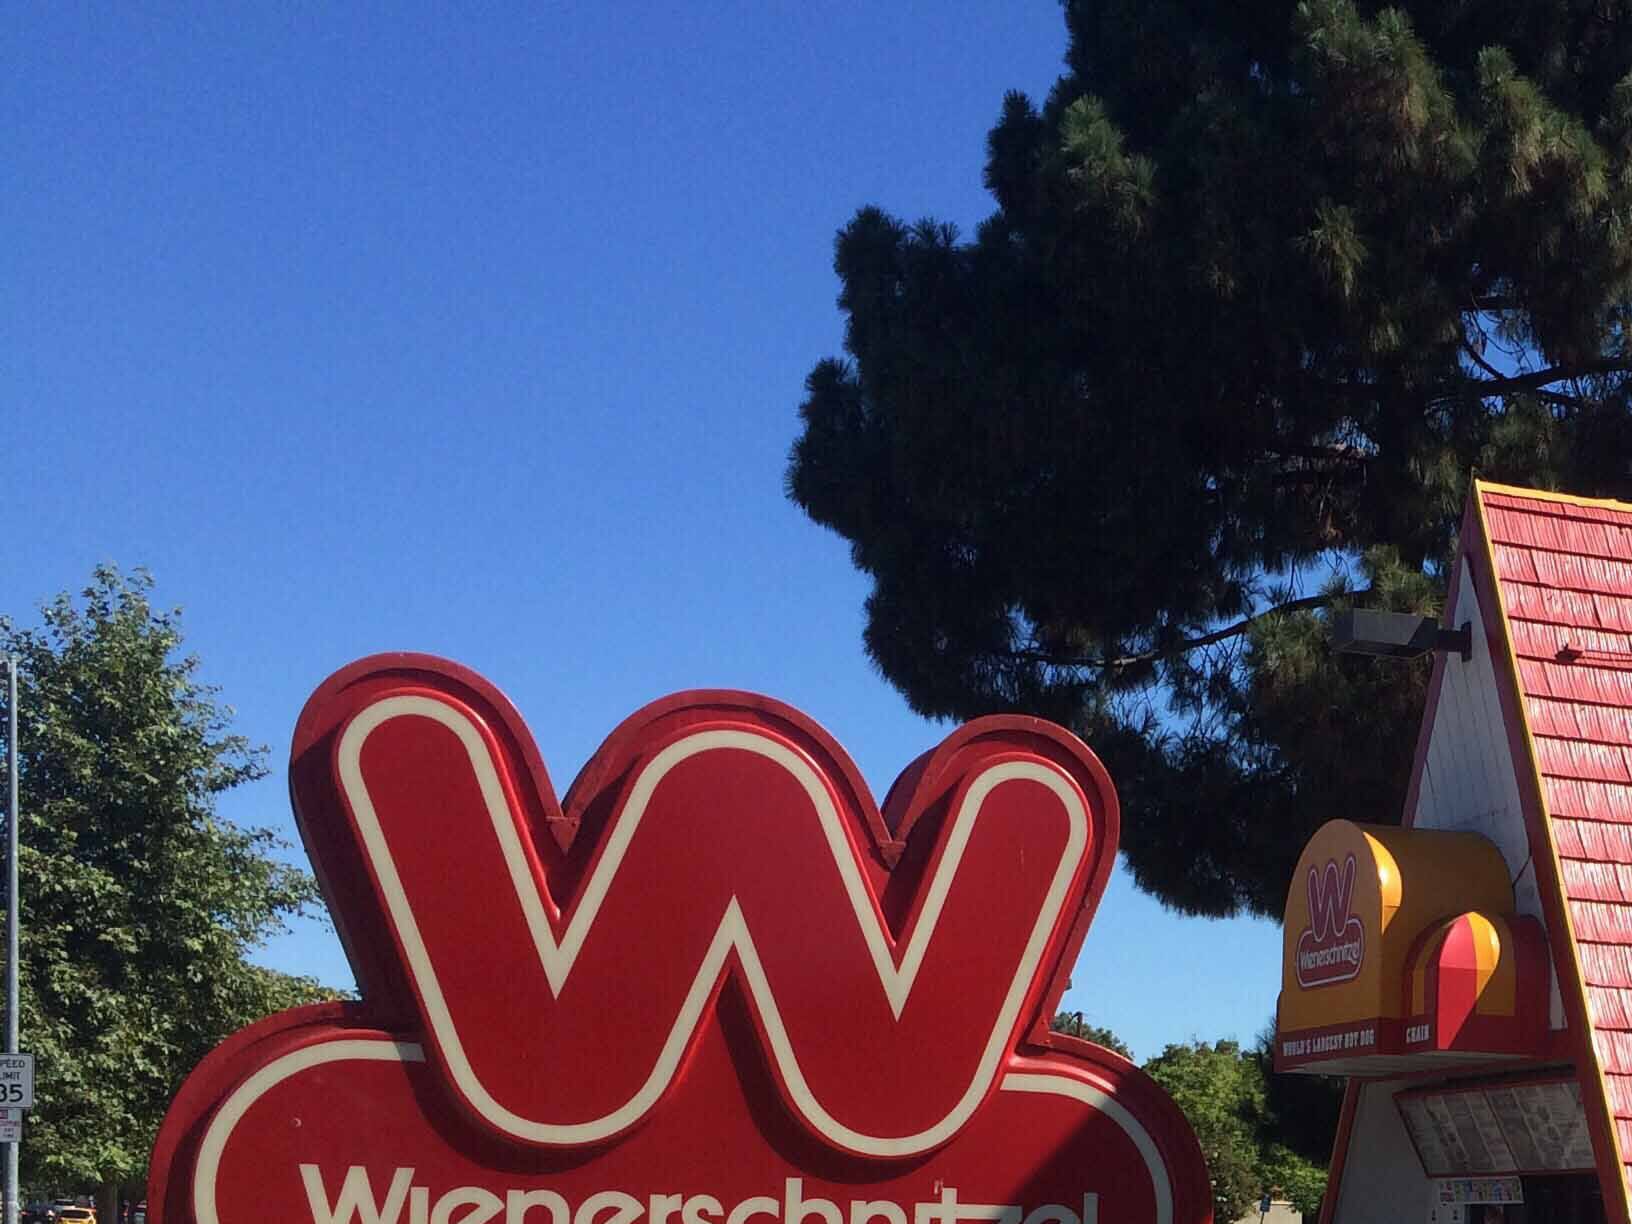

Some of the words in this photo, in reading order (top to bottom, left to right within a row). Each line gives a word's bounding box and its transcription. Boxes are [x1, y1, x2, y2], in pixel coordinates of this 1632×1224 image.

[336, 694, 1089, 1157] W
[1344, 1031, 1359, 1049] HOT
[1360, 1029, 1375, 1047] DOG
[0, 1059, 25, 1068] PEED
[0, 1071, 20, 1080] IMIT
